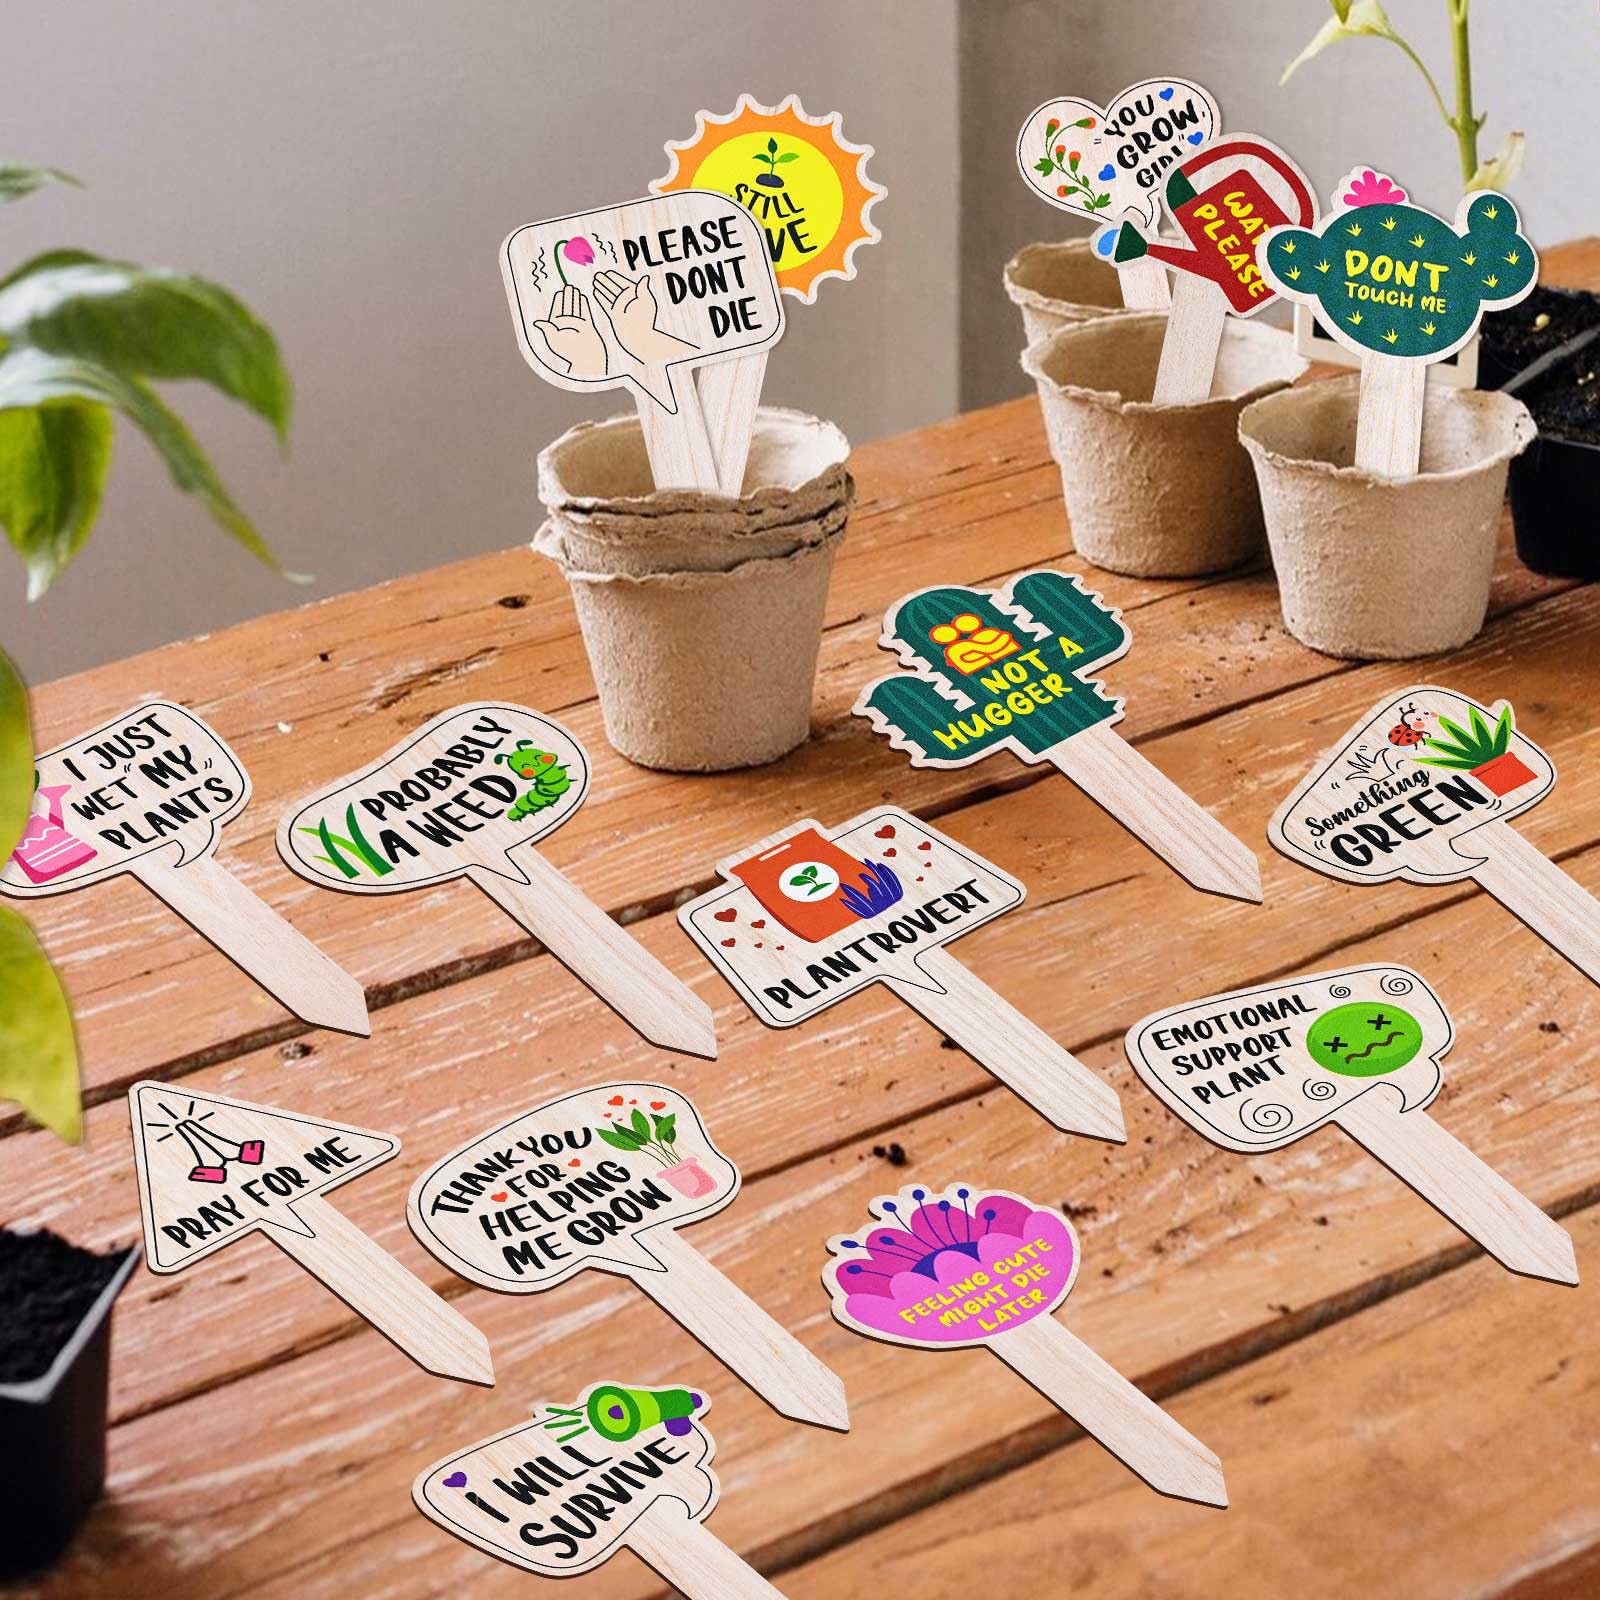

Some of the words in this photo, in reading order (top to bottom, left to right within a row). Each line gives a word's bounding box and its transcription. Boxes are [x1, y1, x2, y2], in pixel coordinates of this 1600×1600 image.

[1104, 93, 1155, 138] YOU
[1116, 98, 1202, 169] GROW
[730, 183, 804, 219] STILL
[622, 215, 743, 271] PLEASE
[1192, 203, 1271, 298] PLEASE
[1344, 248, 1449, 294] DONT
[666, 254, 746, 305] DONT
[1344, 281, 1413, 309] TOUCH
[1420, 295, 1447, 314] ME
[708, 296, 762, 338] DIE
[979, 648, 1049, 695] NOT
[1058, 636, 1084, 659] A
[932, 673, 1073, 751] HUGGER
[62, 758, 88, 782] I
[82, 712, 172, 770] JUST
[359, 715, 512, 822] PROBABLY
[70, 776, 138, 821] WET
[138, 744, 199, 790] MY
[97, 777, 234, 850] PLANTS
[1304, 768, 1431, 837] Something
[379, 829, 421, 864] A
[405, 774, 518, 847] WEED
[1329, 774, 1490, 867] GREEN
[763, 878, 991, 1009] PLANTROVERT
[1151, 994, 1318, 1051] EMOTIONAL
[1171, 1026, 1292, 1077] SUPPORT
[1190, 1054, 1287, 1105] PLANT
[160, 1194, 246, 1249] PRAY
[240, 1166, 311, 1207] FOR
[303, 1136, 362, 1175] ME
[430, 1148, 526, 1218] THANK
[515, 1126, 593, 1158] YOU
[478, 1160, 632, 1241] HELPING
[504, 1163, 567, 1198] FOR
[501, 1231, 574, 1276] ME
[566, 1177, 674, 1246] GROW
[898, 1270, 991, 1325] FEELING
[992, 1237, 1053, 1275] CUTE
[937, 1283, 1009, 1328] MIGHT
[1010, 1262, 1052, 1289] DIE
[976, 1287, 1048, 1332] LATER
[492, 1445, 614, 1506] WILL
[518, 1437, 691, 1560] SURVIVE
